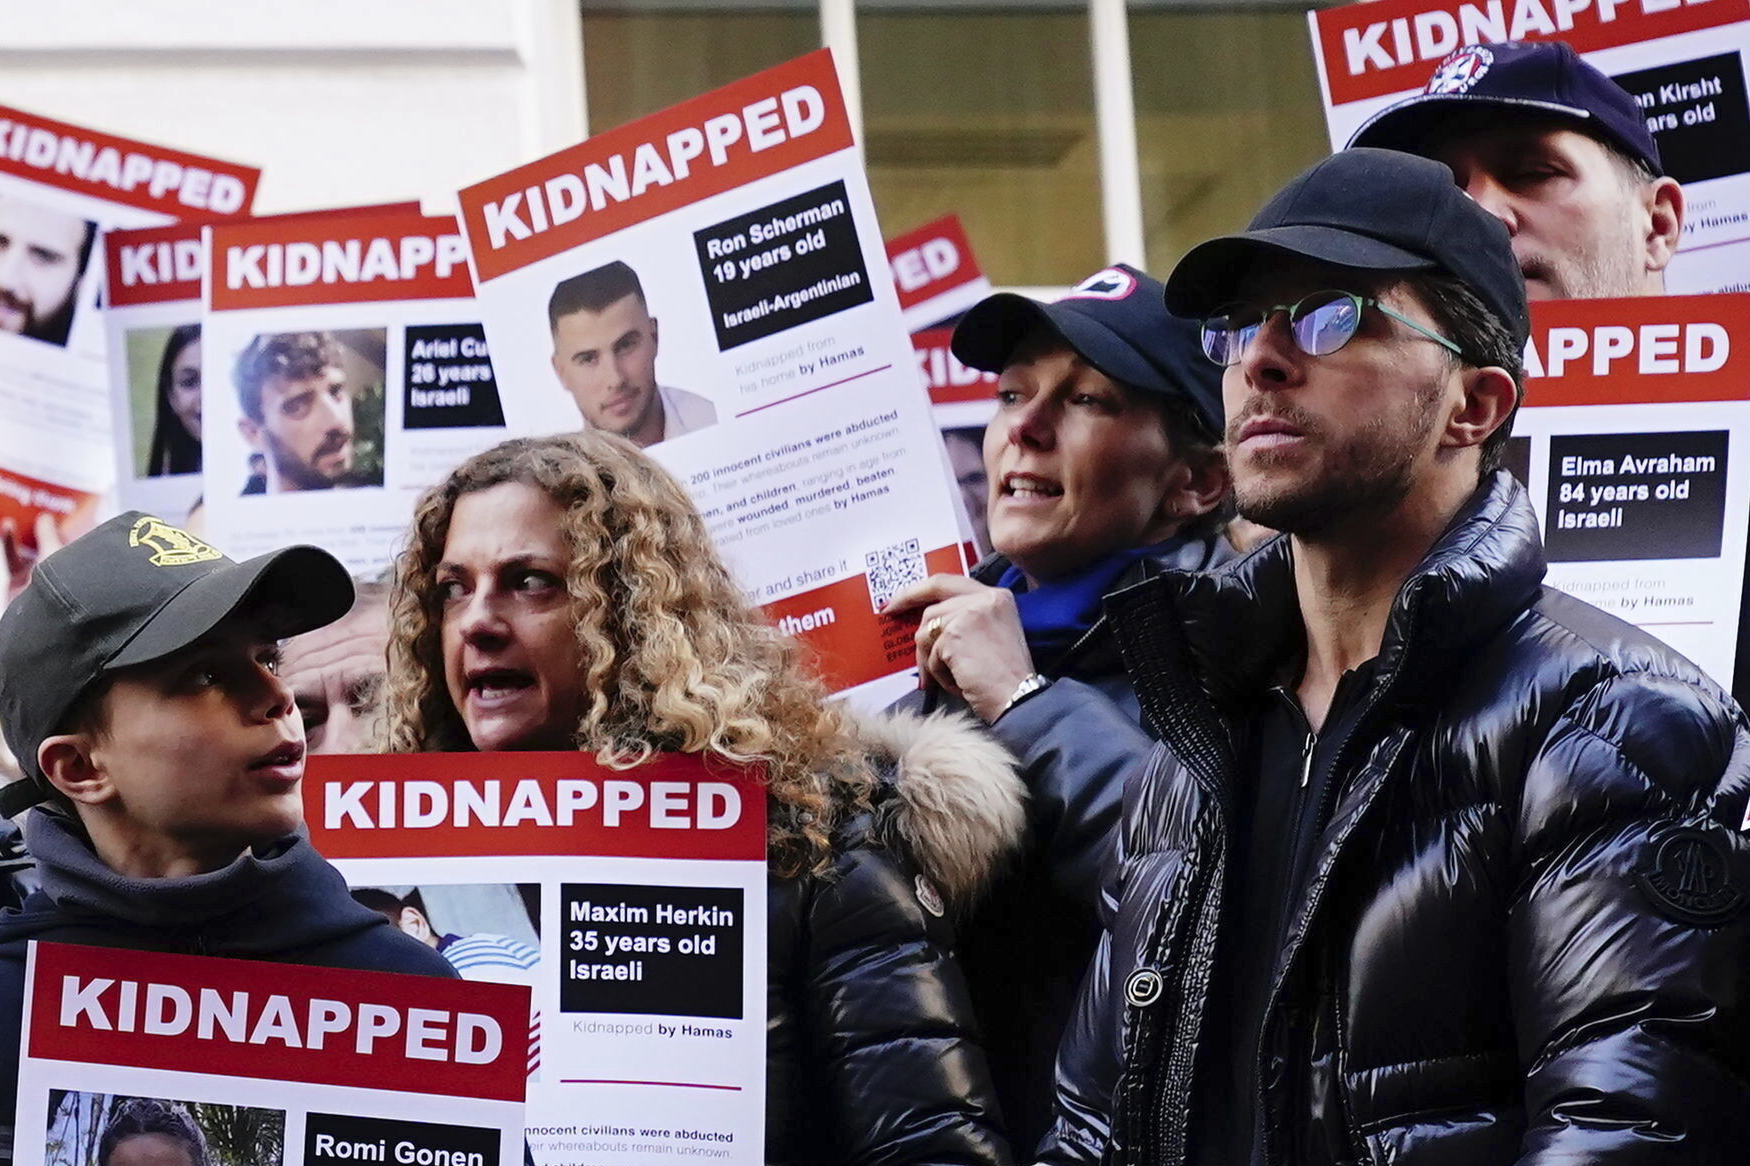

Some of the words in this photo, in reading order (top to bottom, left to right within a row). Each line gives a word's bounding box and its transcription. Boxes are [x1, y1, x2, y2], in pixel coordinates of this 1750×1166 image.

[1660, 76, 1722, 107] Kirsht
[1683, 101, 1715, 125] old
[483, 86, 824, 248] KIDNAPPED
[706, 233, 747, 259] Ron
[749, 200, 844, 243] Scherman
[712, 260, 736, 283] 19
[738, 244, 792, 279] years
[794, 227, 826, 255] old
[723, 272, 860, 327] Israeli-Argentinian
[411, 387, 471, 409] Israeli
[1560, 455, 1614, 477] Elma
[1619, 453, 1716, 474] Avraham
[1559, 482, 1585, 503] 84
[1590, 484, 1649, 506] years
[1655, 479, 1690, 500] old
[1557, 508, 1623, 529] Israeli
[325, 779, 740, 829] KIDNAPPED
[570, 900, 648, 923] Maxim
[655, 903, 733, 927] Herkin
[569, 929, 598, 951] 35
[604, 935, 671, 956] years
[677, 934, 716, 955] old
[569, 958, 642, 981] Israeli
[60, 975, 502, 1064] KIDNAPPED
[573, 1021, 654, 1038] Kidnapped
[657, 1022, 676, 1038] by
[680, 1024, 733, 1039] Hamas
[315, 1133, 385, 1162] Romi
